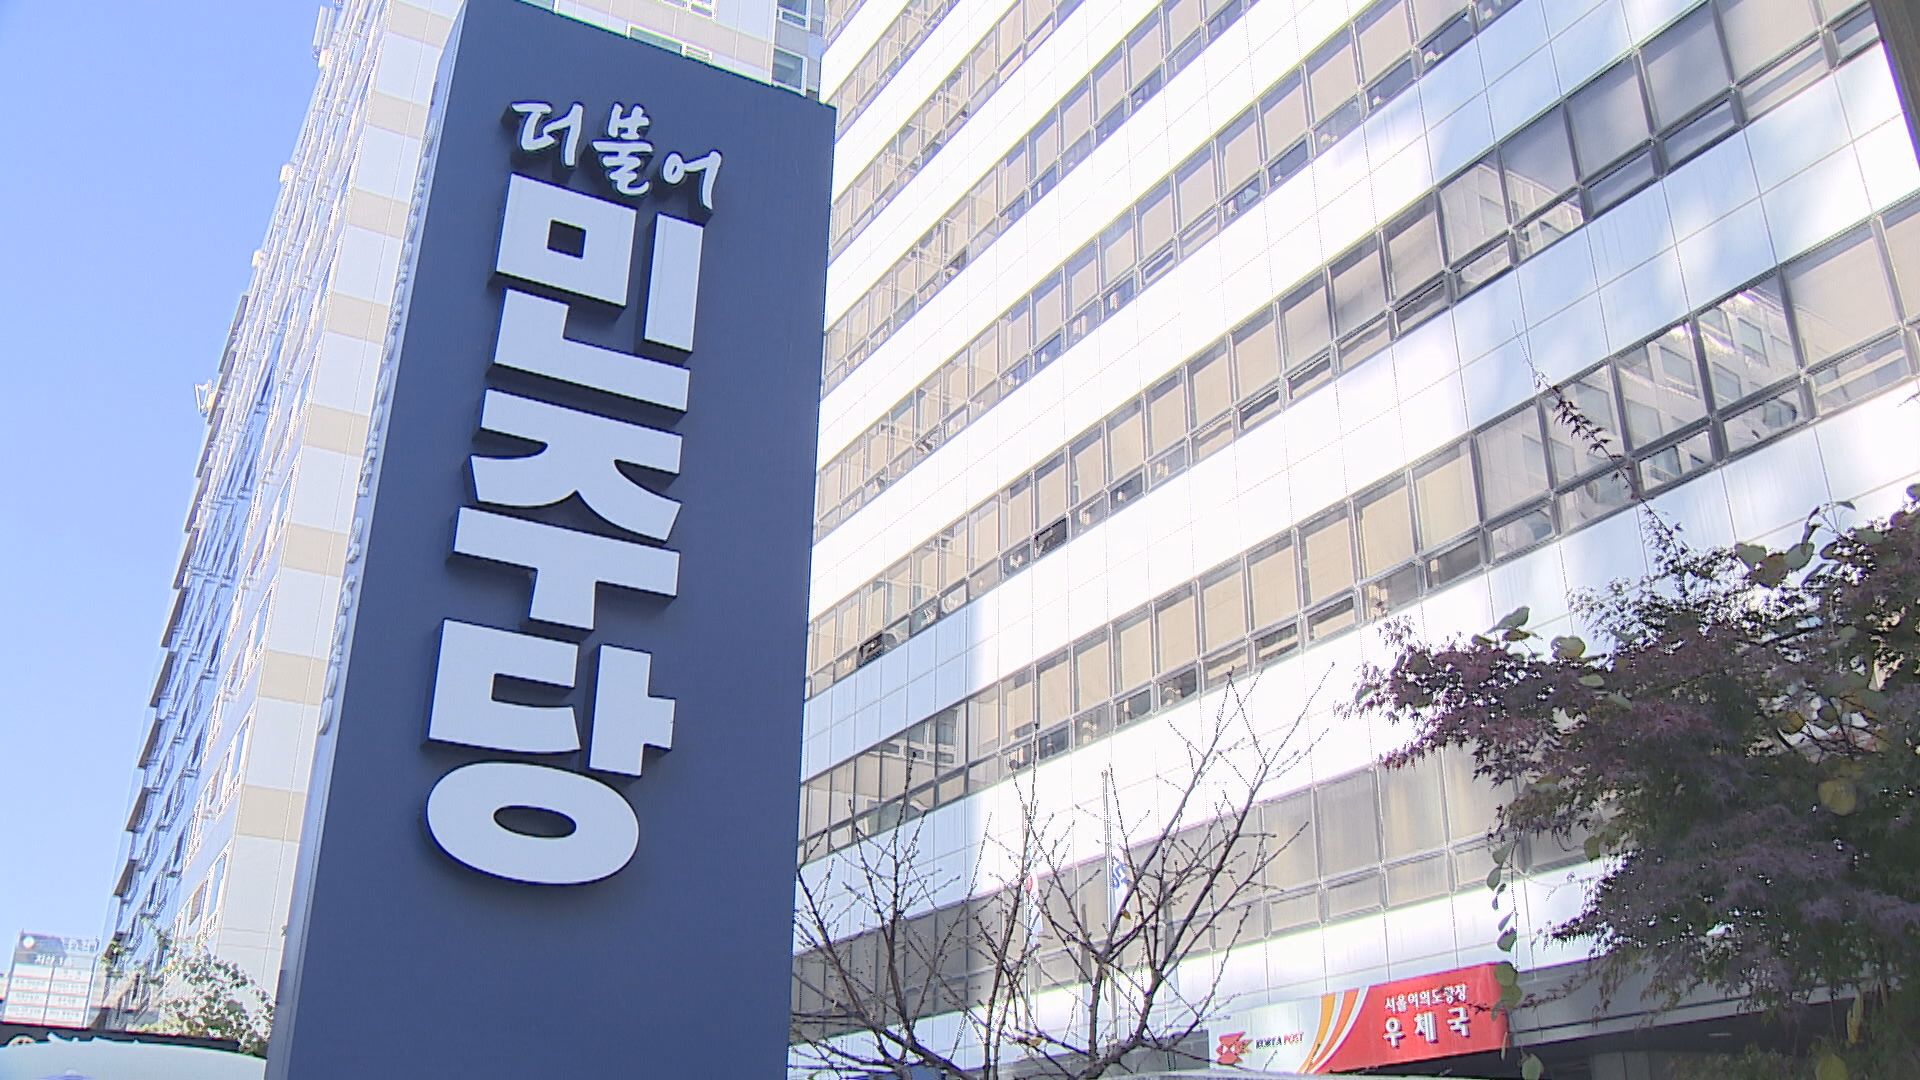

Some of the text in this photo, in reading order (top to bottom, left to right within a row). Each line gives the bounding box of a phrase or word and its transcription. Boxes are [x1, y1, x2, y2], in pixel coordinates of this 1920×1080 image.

[511, 101, 722, 210] 더불어
[427, 171, 705, 885] 민주당
[1382, 1006, 1471, 1047] 우체국
